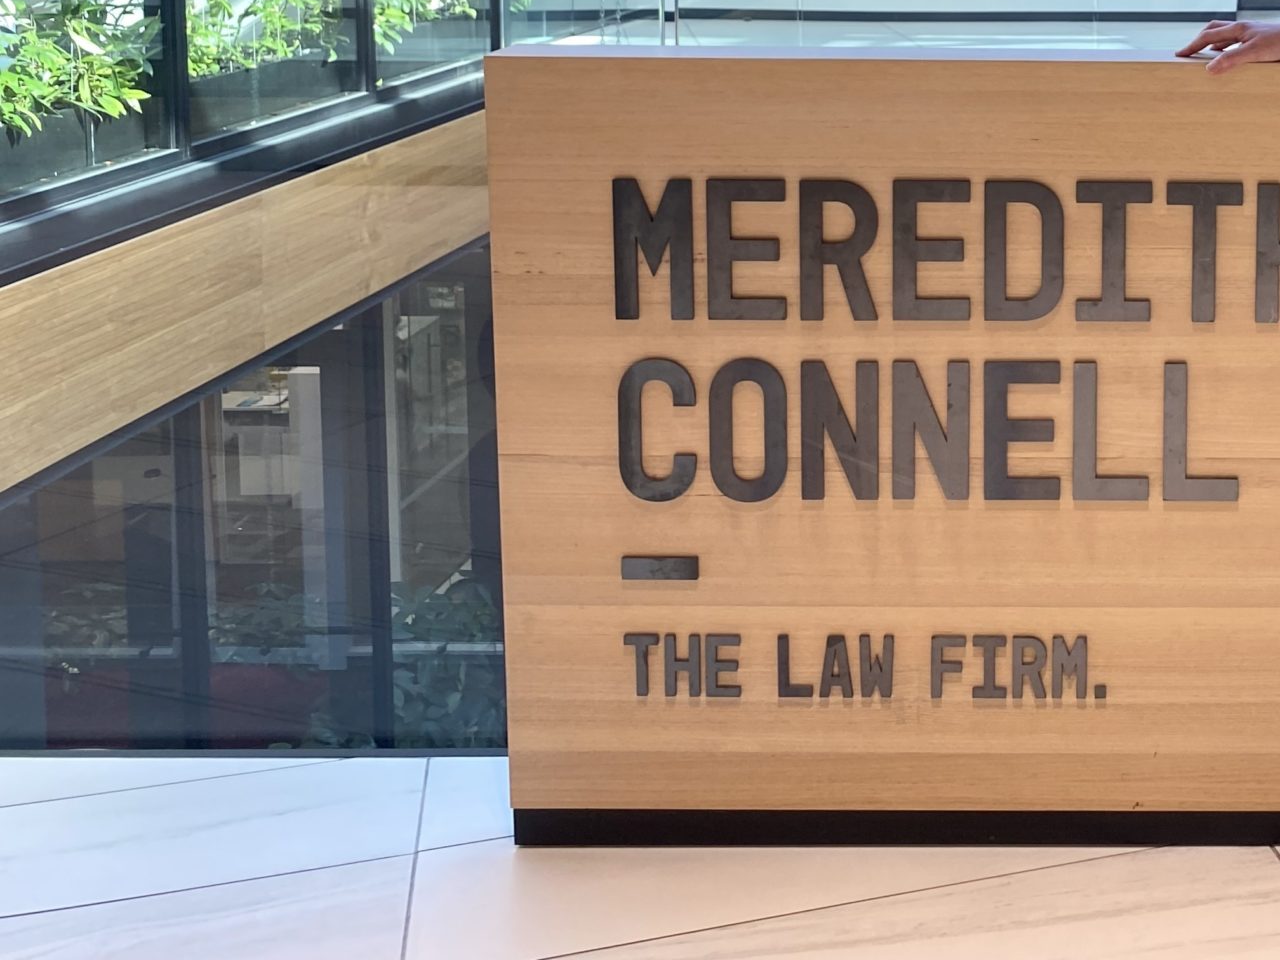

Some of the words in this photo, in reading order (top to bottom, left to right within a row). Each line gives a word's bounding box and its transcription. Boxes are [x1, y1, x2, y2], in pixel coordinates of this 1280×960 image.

[617, 357, 1240, 503] CONNELL
[623, 632, 742, 698] THE
[776, 632, 895, 699] LAW
[929, 634, 1107, 700] FIRM.
